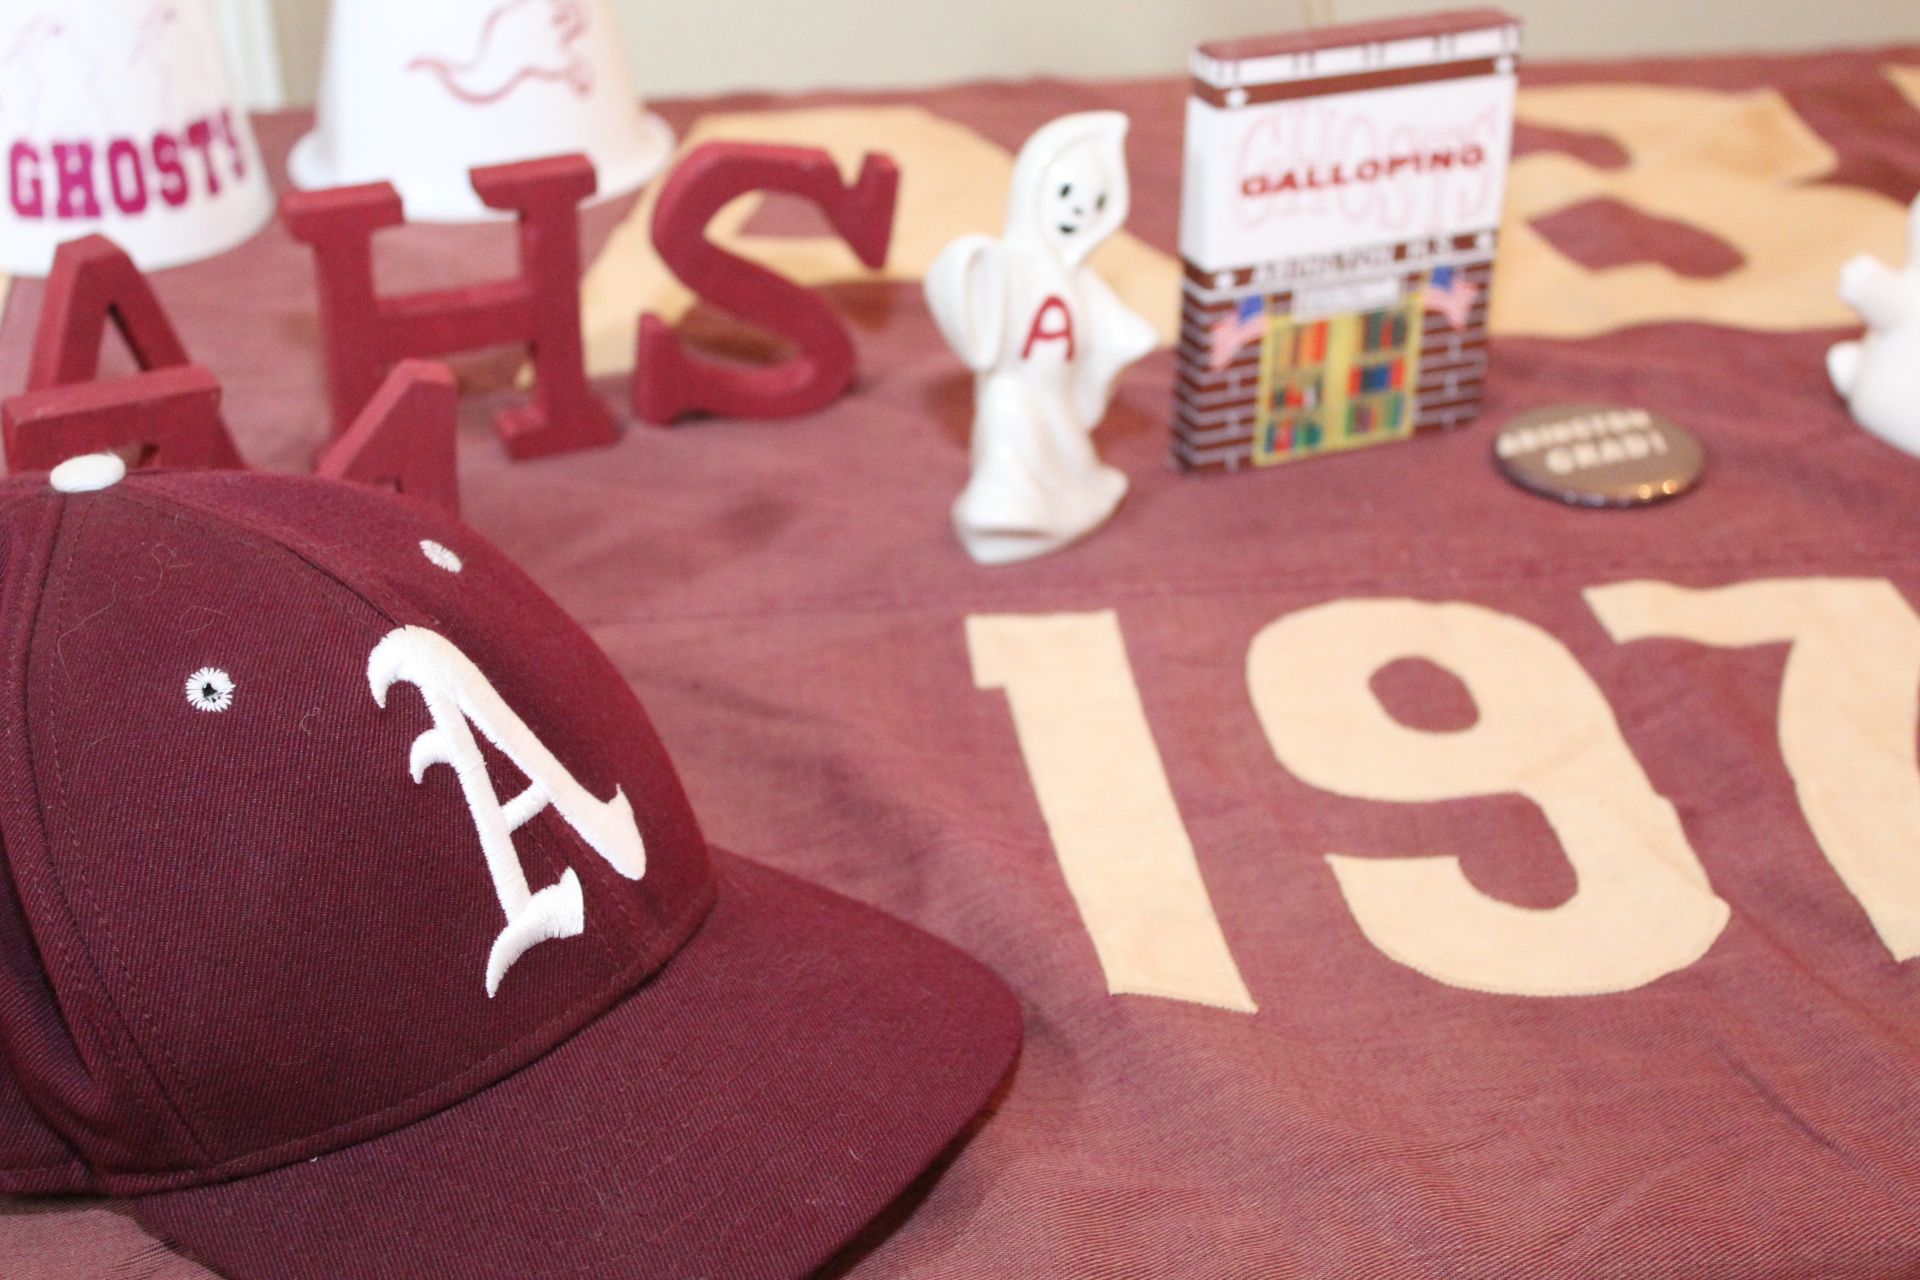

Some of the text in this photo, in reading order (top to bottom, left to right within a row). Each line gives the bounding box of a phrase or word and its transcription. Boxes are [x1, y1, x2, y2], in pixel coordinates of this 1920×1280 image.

[1241, 143, 1484, 197] GALLOPING
[1022, 295, 1075, 362] A
[367, 625, 646, 999] A
